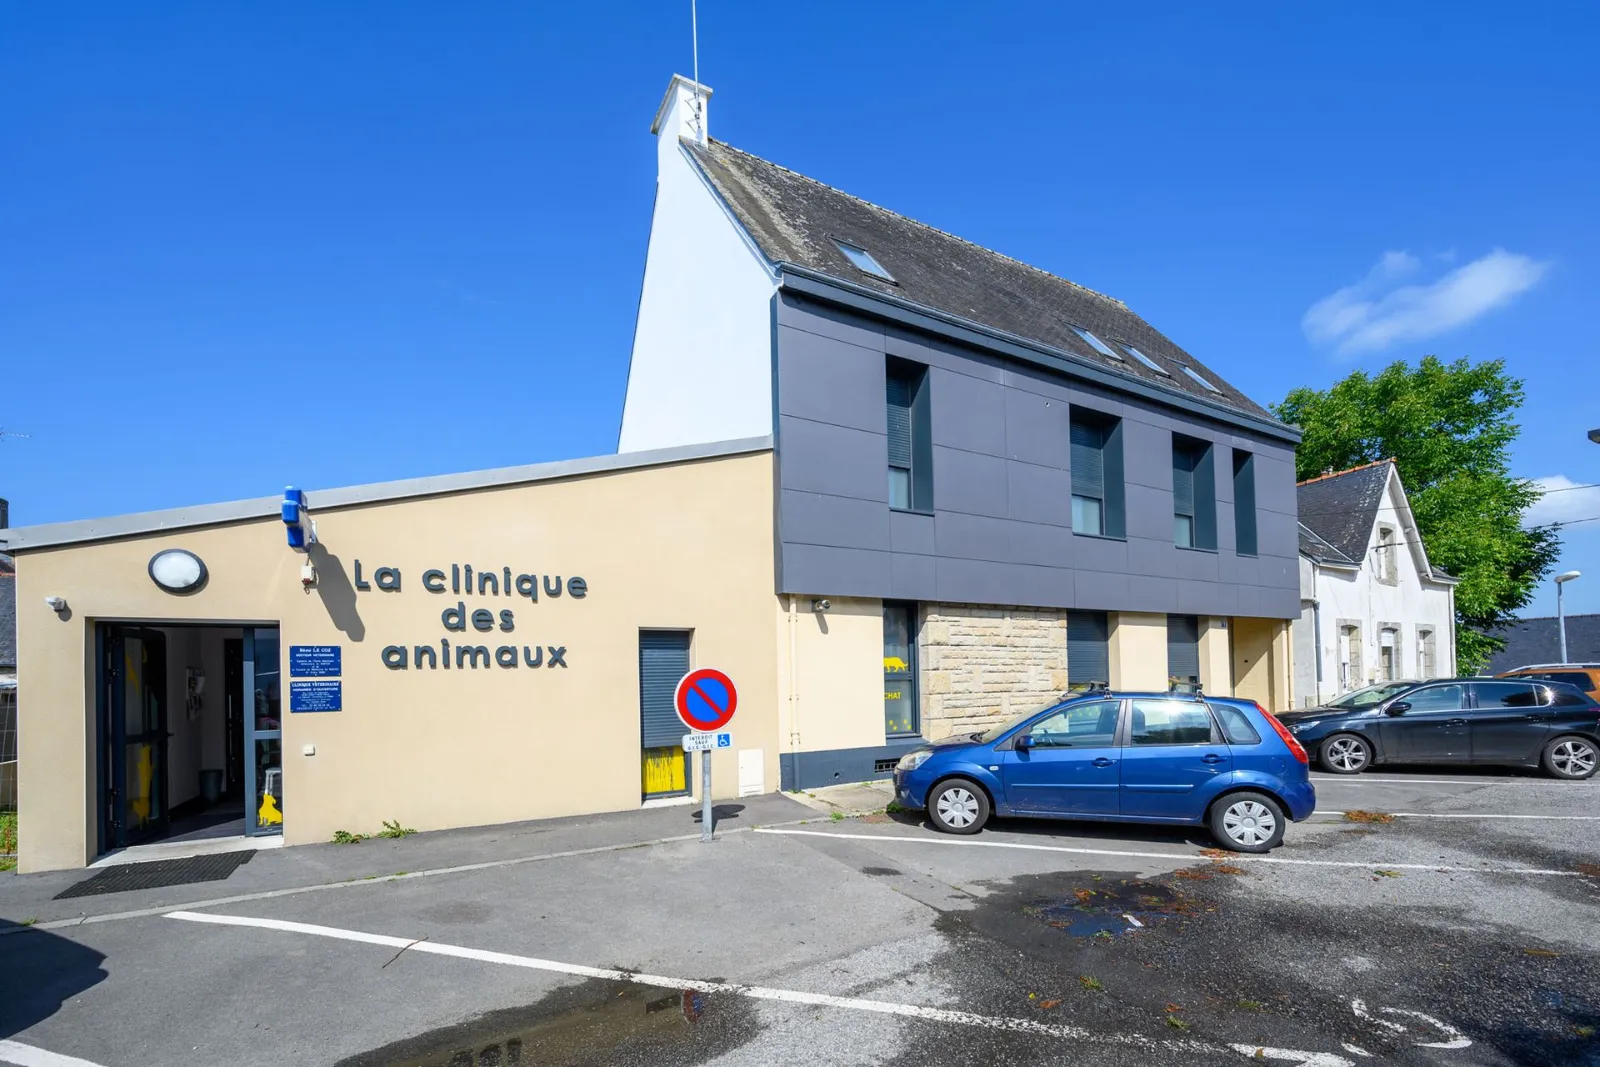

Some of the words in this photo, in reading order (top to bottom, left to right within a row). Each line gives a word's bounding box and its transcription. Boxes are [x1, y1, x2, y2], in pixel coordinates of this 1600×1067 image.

[354, 559, 401, 592] La
[422, 564, 588, 604] clinique
[441, 602, 515, 633] des
[381, 638, 568, 670] animaux
